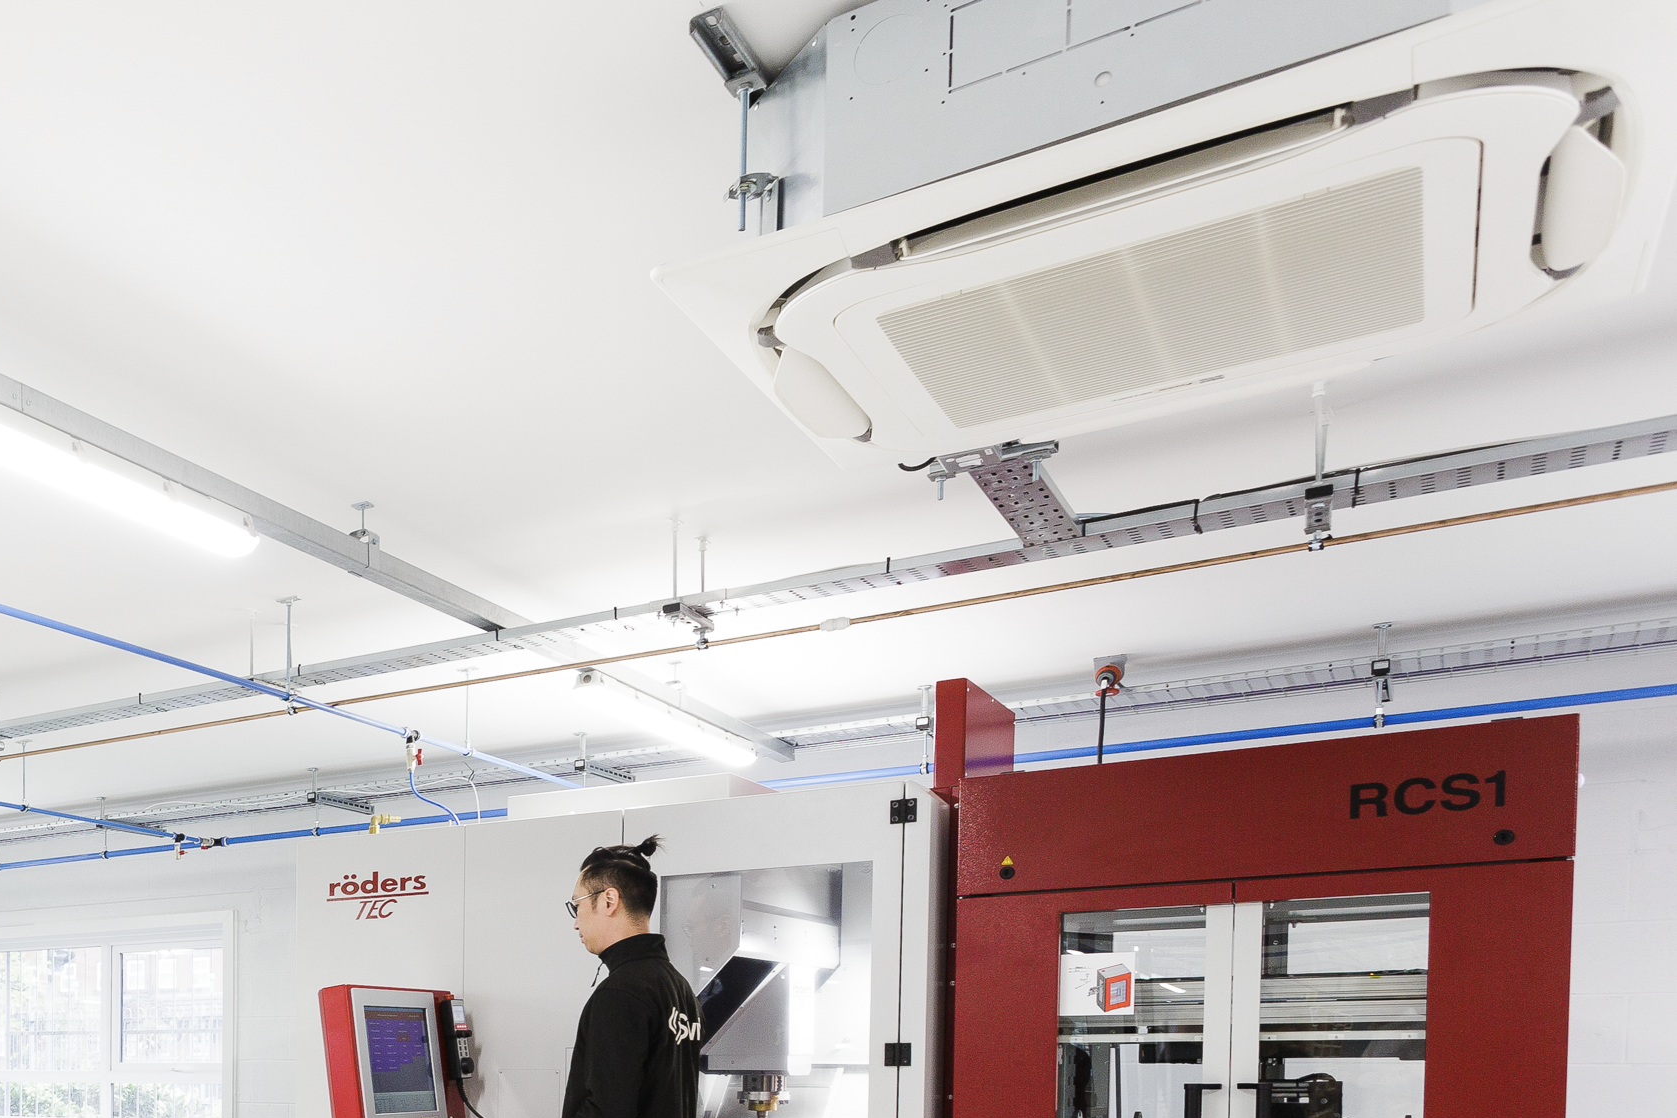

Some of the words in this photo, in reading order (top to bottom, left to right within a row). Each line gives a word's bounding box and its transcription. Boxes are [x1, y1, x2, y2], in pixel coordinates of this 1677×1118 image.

[1349, 770, 1506, 819] RCS1
[329, 871, 427, 896] röders
[355, 898, 398, 920] TEC
